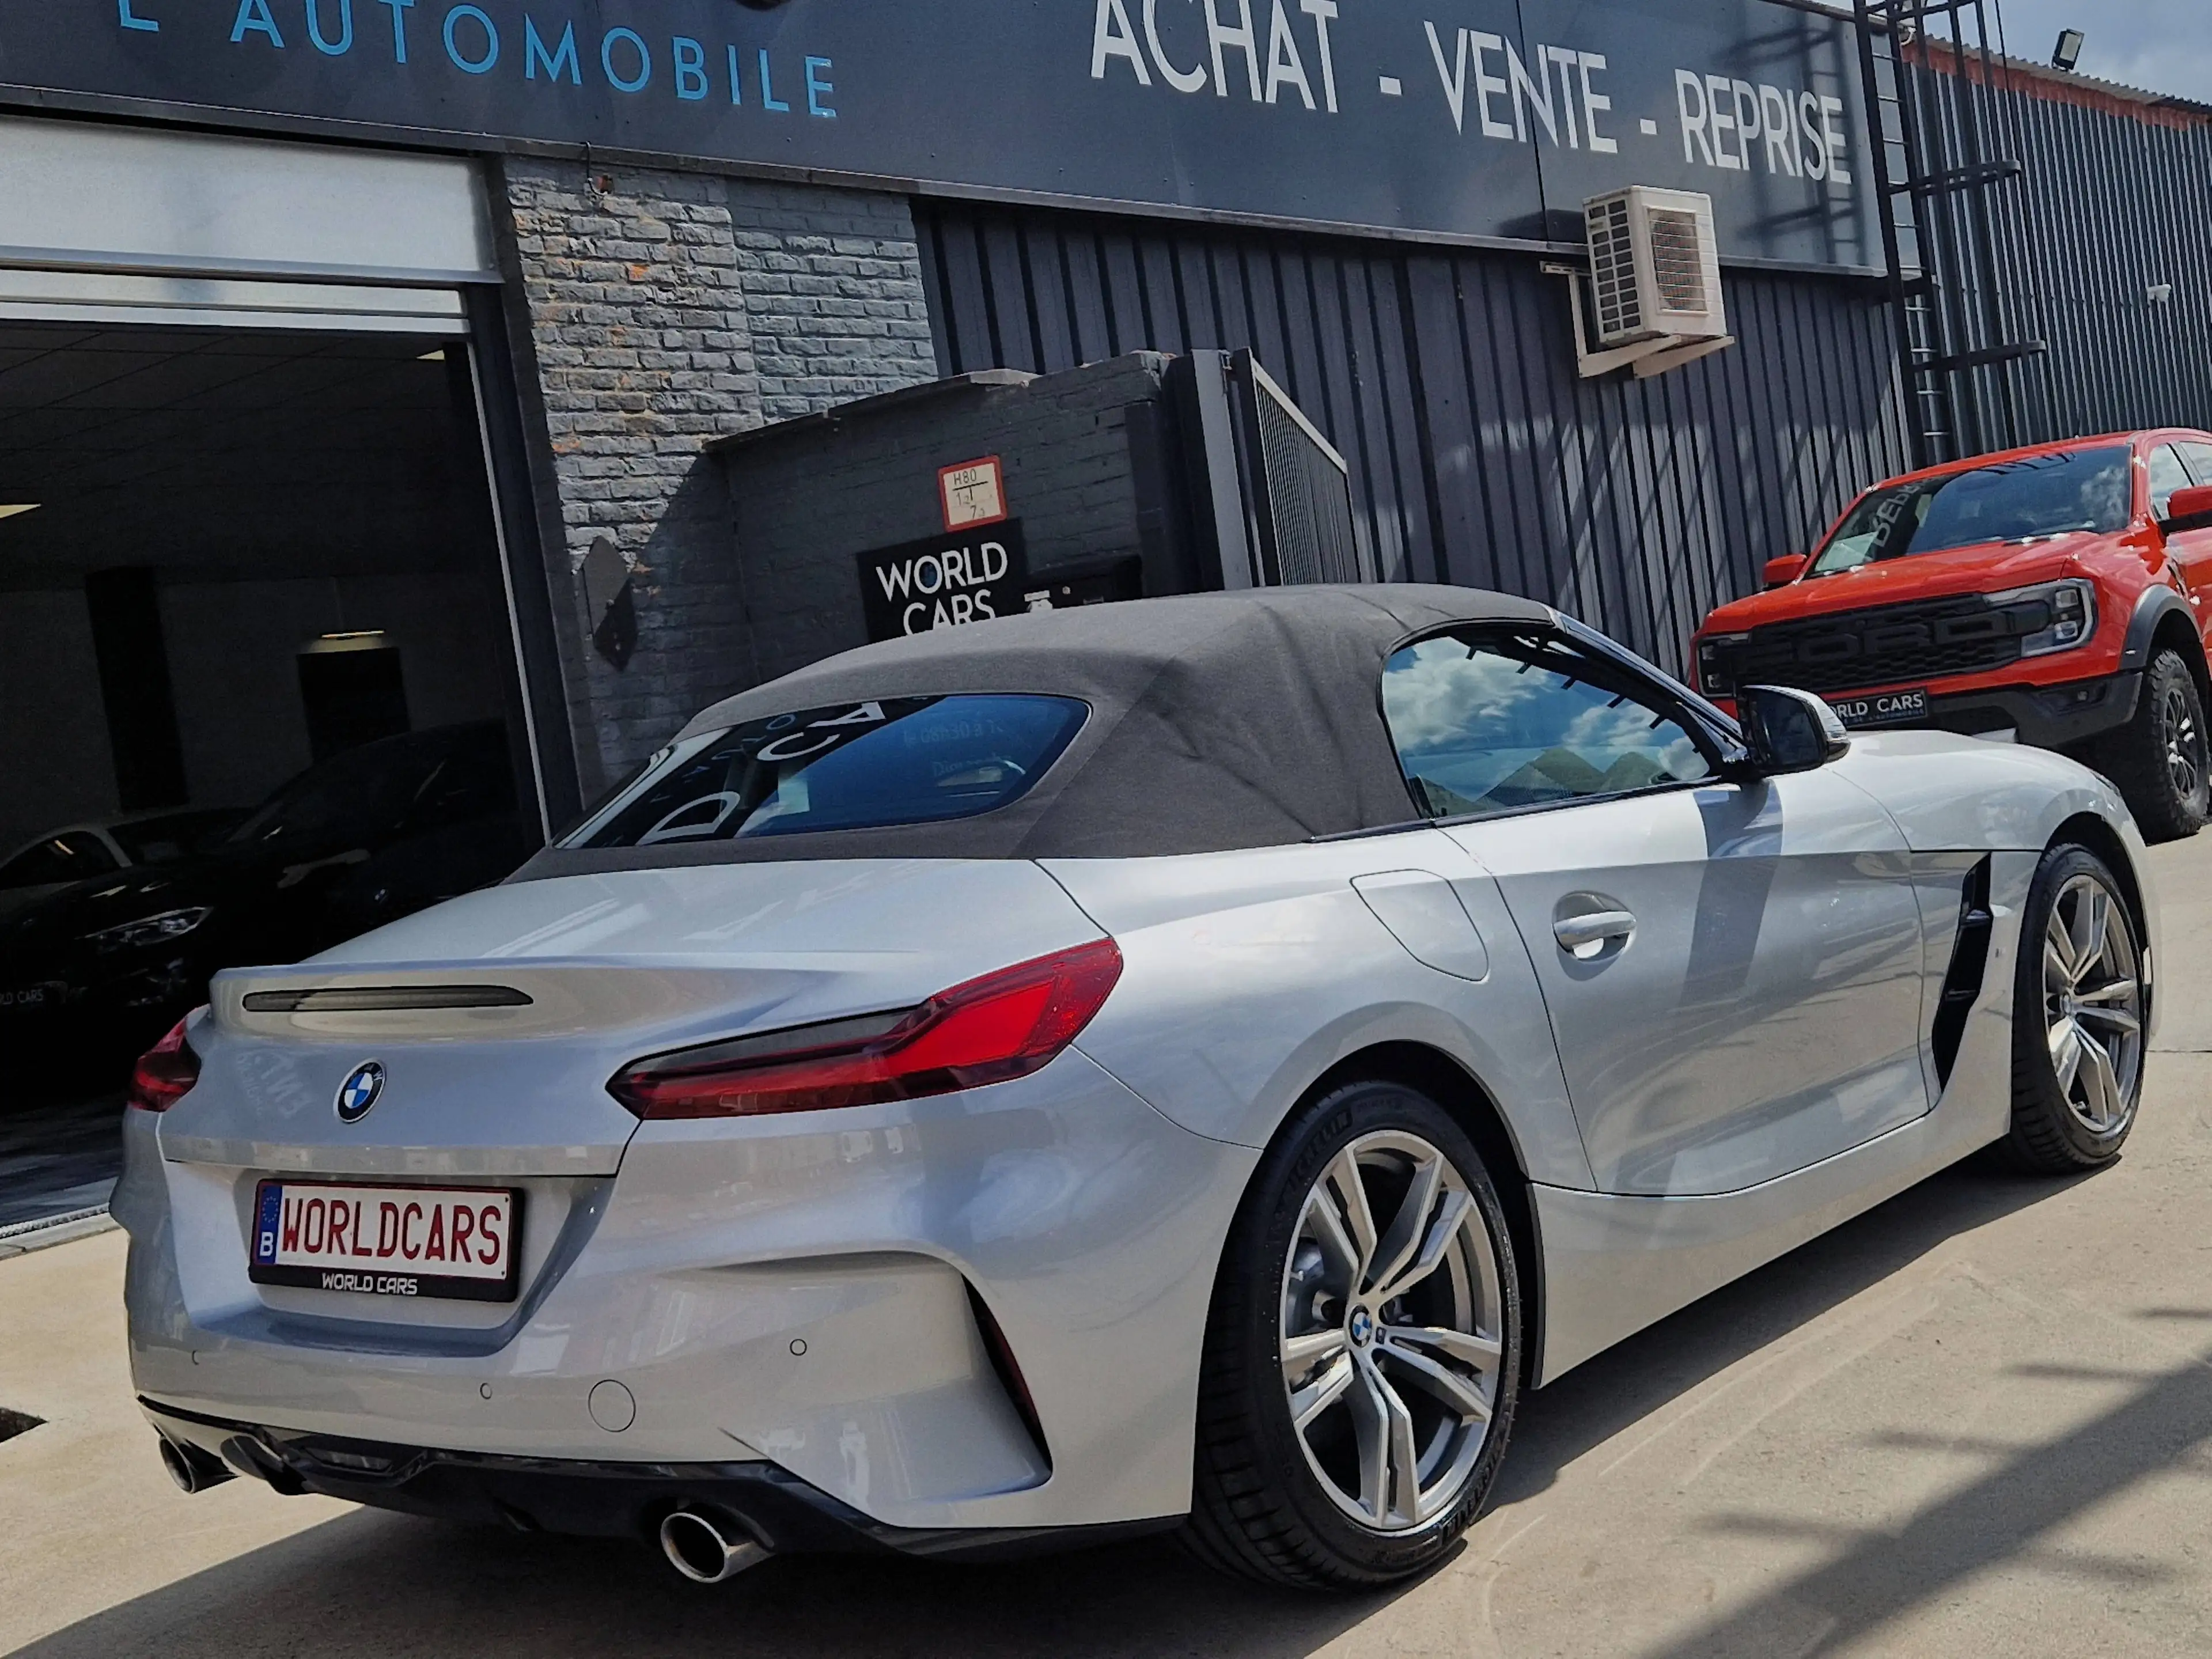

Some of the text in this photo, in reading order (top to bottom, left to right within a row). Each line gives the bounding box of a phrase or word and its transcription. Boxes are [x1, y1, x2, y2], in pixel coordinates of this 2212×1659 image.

[1091, 0, 1338, 113] ACHAT
[1423, 20, 1618, 154] VENTE
[1675, 69, 1851, 184] REPRISE
[876, 541, 1008, 602] WORLD
[903, 589, 996, 635] CARS
[1877, 694, 1924, 713] CARS
[260, 1232, 274, 1256] B
[282, 1198, 502, 1266] WORLDCARS
[322, 1272, 418, 1295] WORLD CARS
